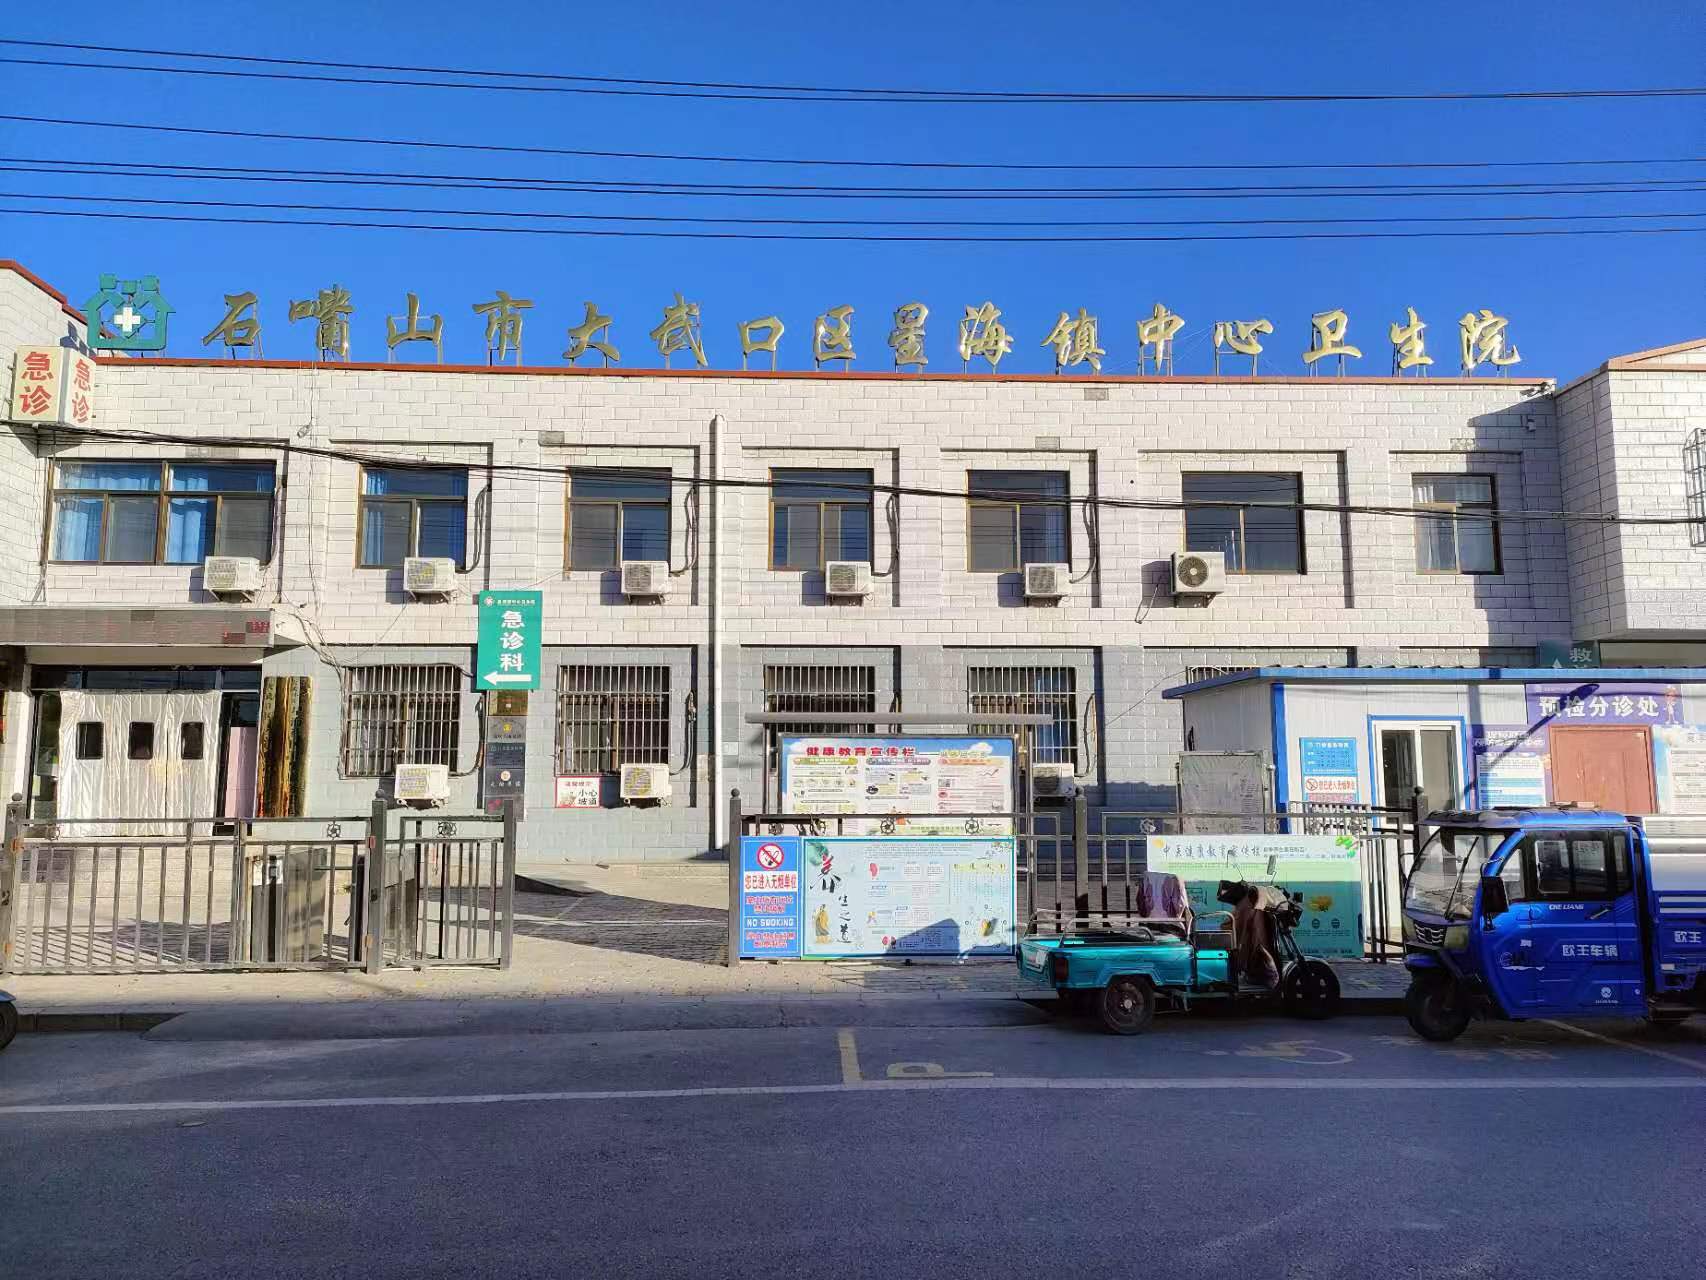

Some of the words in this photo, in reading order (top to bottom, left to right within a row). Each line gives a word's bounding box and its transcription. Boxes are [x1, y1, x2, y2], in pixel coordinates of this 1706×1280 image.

[203, 284, 1521, 371] 石嘴山市大武口区星海镇中心卫生院
[19, 351, 54, 416] 急诊
[71, 358, 91, 423] 急诊
[499, 610, 525, 672] 急诊科
[1538, 695, 1660, 719] 预检分诊处
[806, 746, 916, 757] 健康教育宣传栏
[578, 788, 598, 797] 小心
[745, 874, 797, 890] 您已进入无烟单位
[746, 919, 758, 927] NO
[1674, 930, 1702, 943] 欧王
[1562, 944, 1619, 957] 欧王车辆
